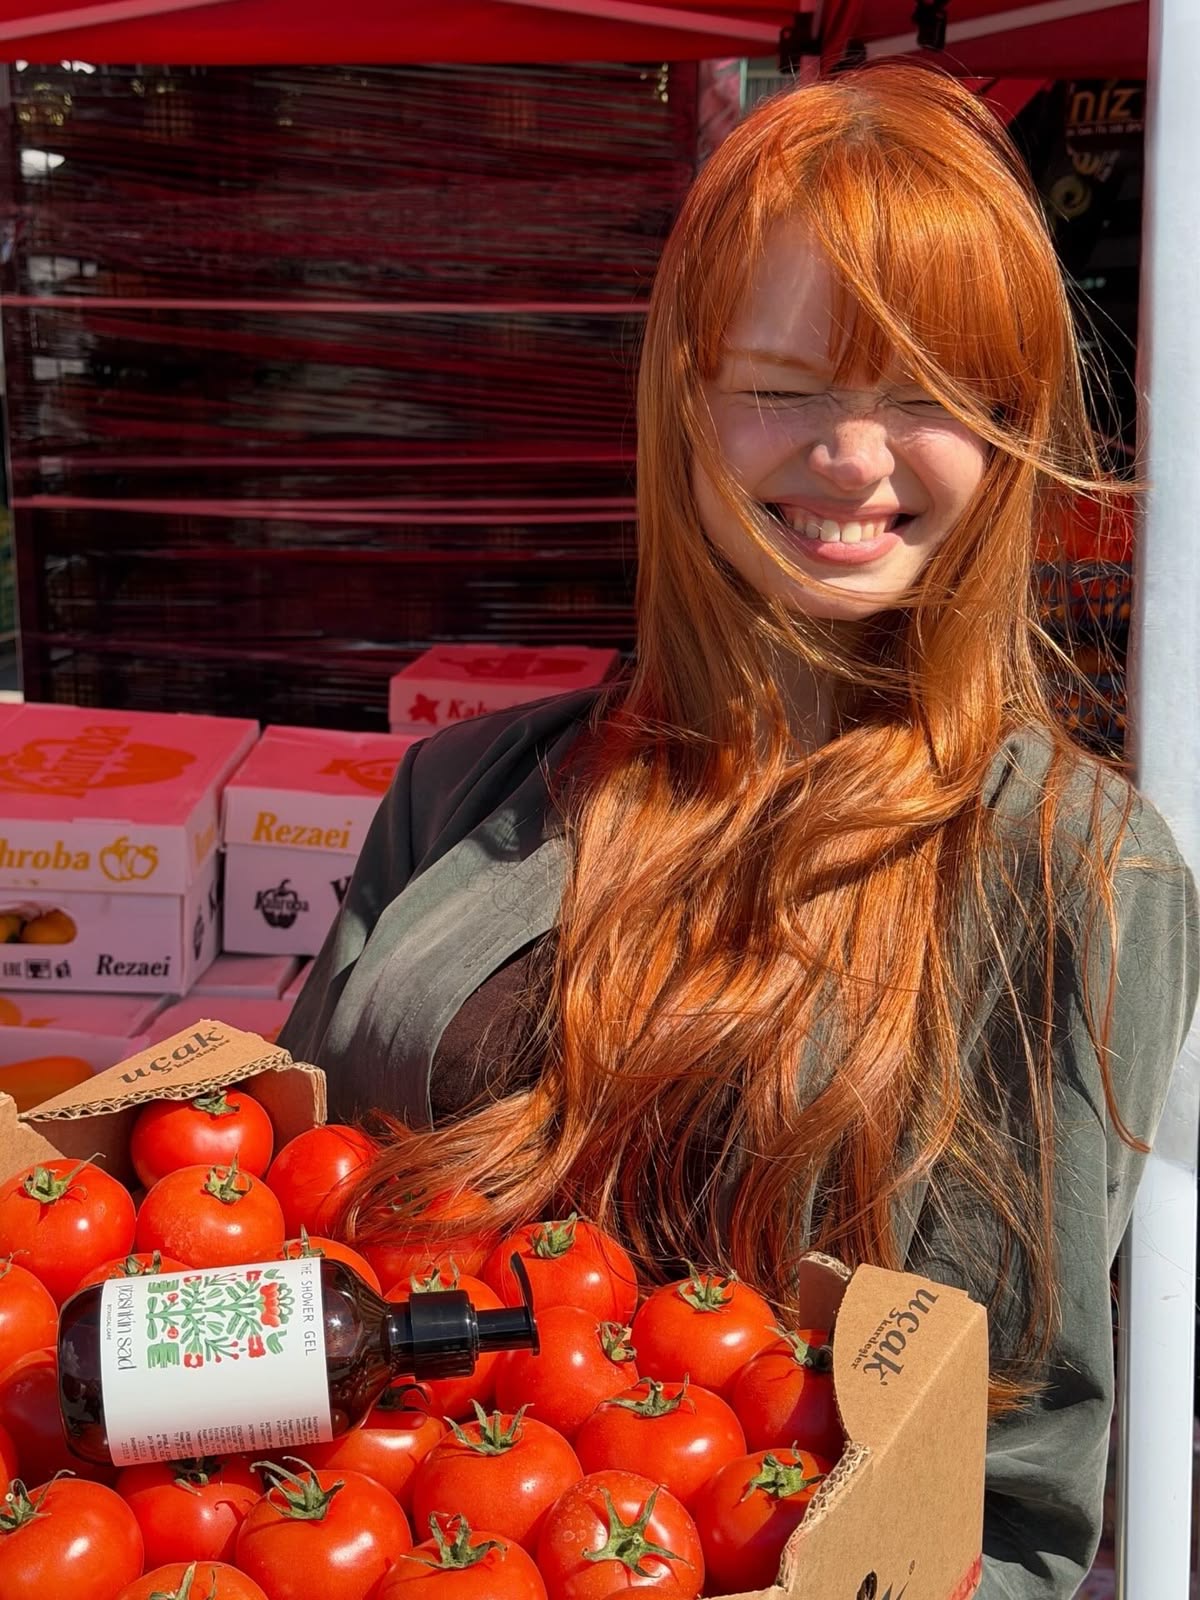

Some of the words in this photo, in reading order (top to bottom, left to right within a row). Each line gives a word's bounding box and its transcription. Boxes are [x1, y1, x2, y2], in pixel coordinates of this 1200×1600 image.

[252, 810, 352, 849] Rezaei
[0, 837, 91, 871] hroba
[96, 953, 171, 977] Rezaei
[118, 1028, 225, 1084] uçak
[301, 1263, 312, 1276] THE
[301, 1280, 315, 1323] SHOWER
[304, 1330, 317, 1357] GEL
[863, 1288, 940, 1381] uçak
[116, 1337, 137, 1370] sad
